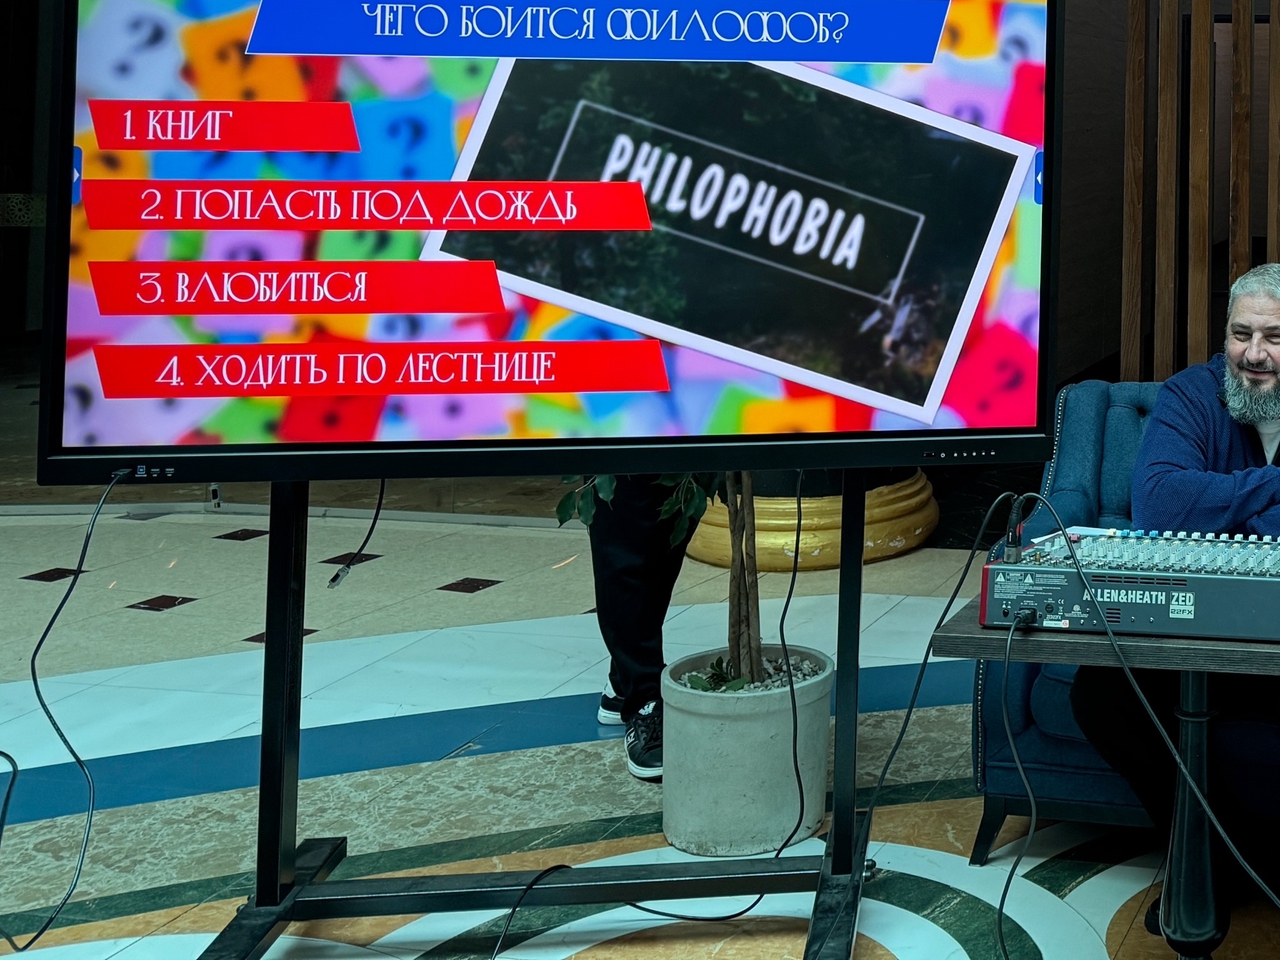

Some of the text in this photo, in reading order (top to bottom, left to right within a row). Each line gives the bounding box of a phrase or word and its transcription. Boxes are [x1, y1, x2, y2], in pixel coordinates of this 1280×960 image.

[361, 3, 849, 43] ЧЕГО БОИТСЯ ФИЛОФОБ?
[123, 110, 233, 140] 1. КНИГ
[140, 189, 578, 224] 2. ПОПАСТЬ ПОД ДОЖДЬ
[601, 134, 866, 271] PHILOPHOBIA
[137, 271, 368, 304] 3. ВЛЮБИТЬСЯ
[155, 351, 556, 389] 4. ХОДИТЬ ПО ЛЕСТНИЦЕ
[1170, 608, 1193, 616] 22FX
[1171, 592, 1194, 606] ZED
